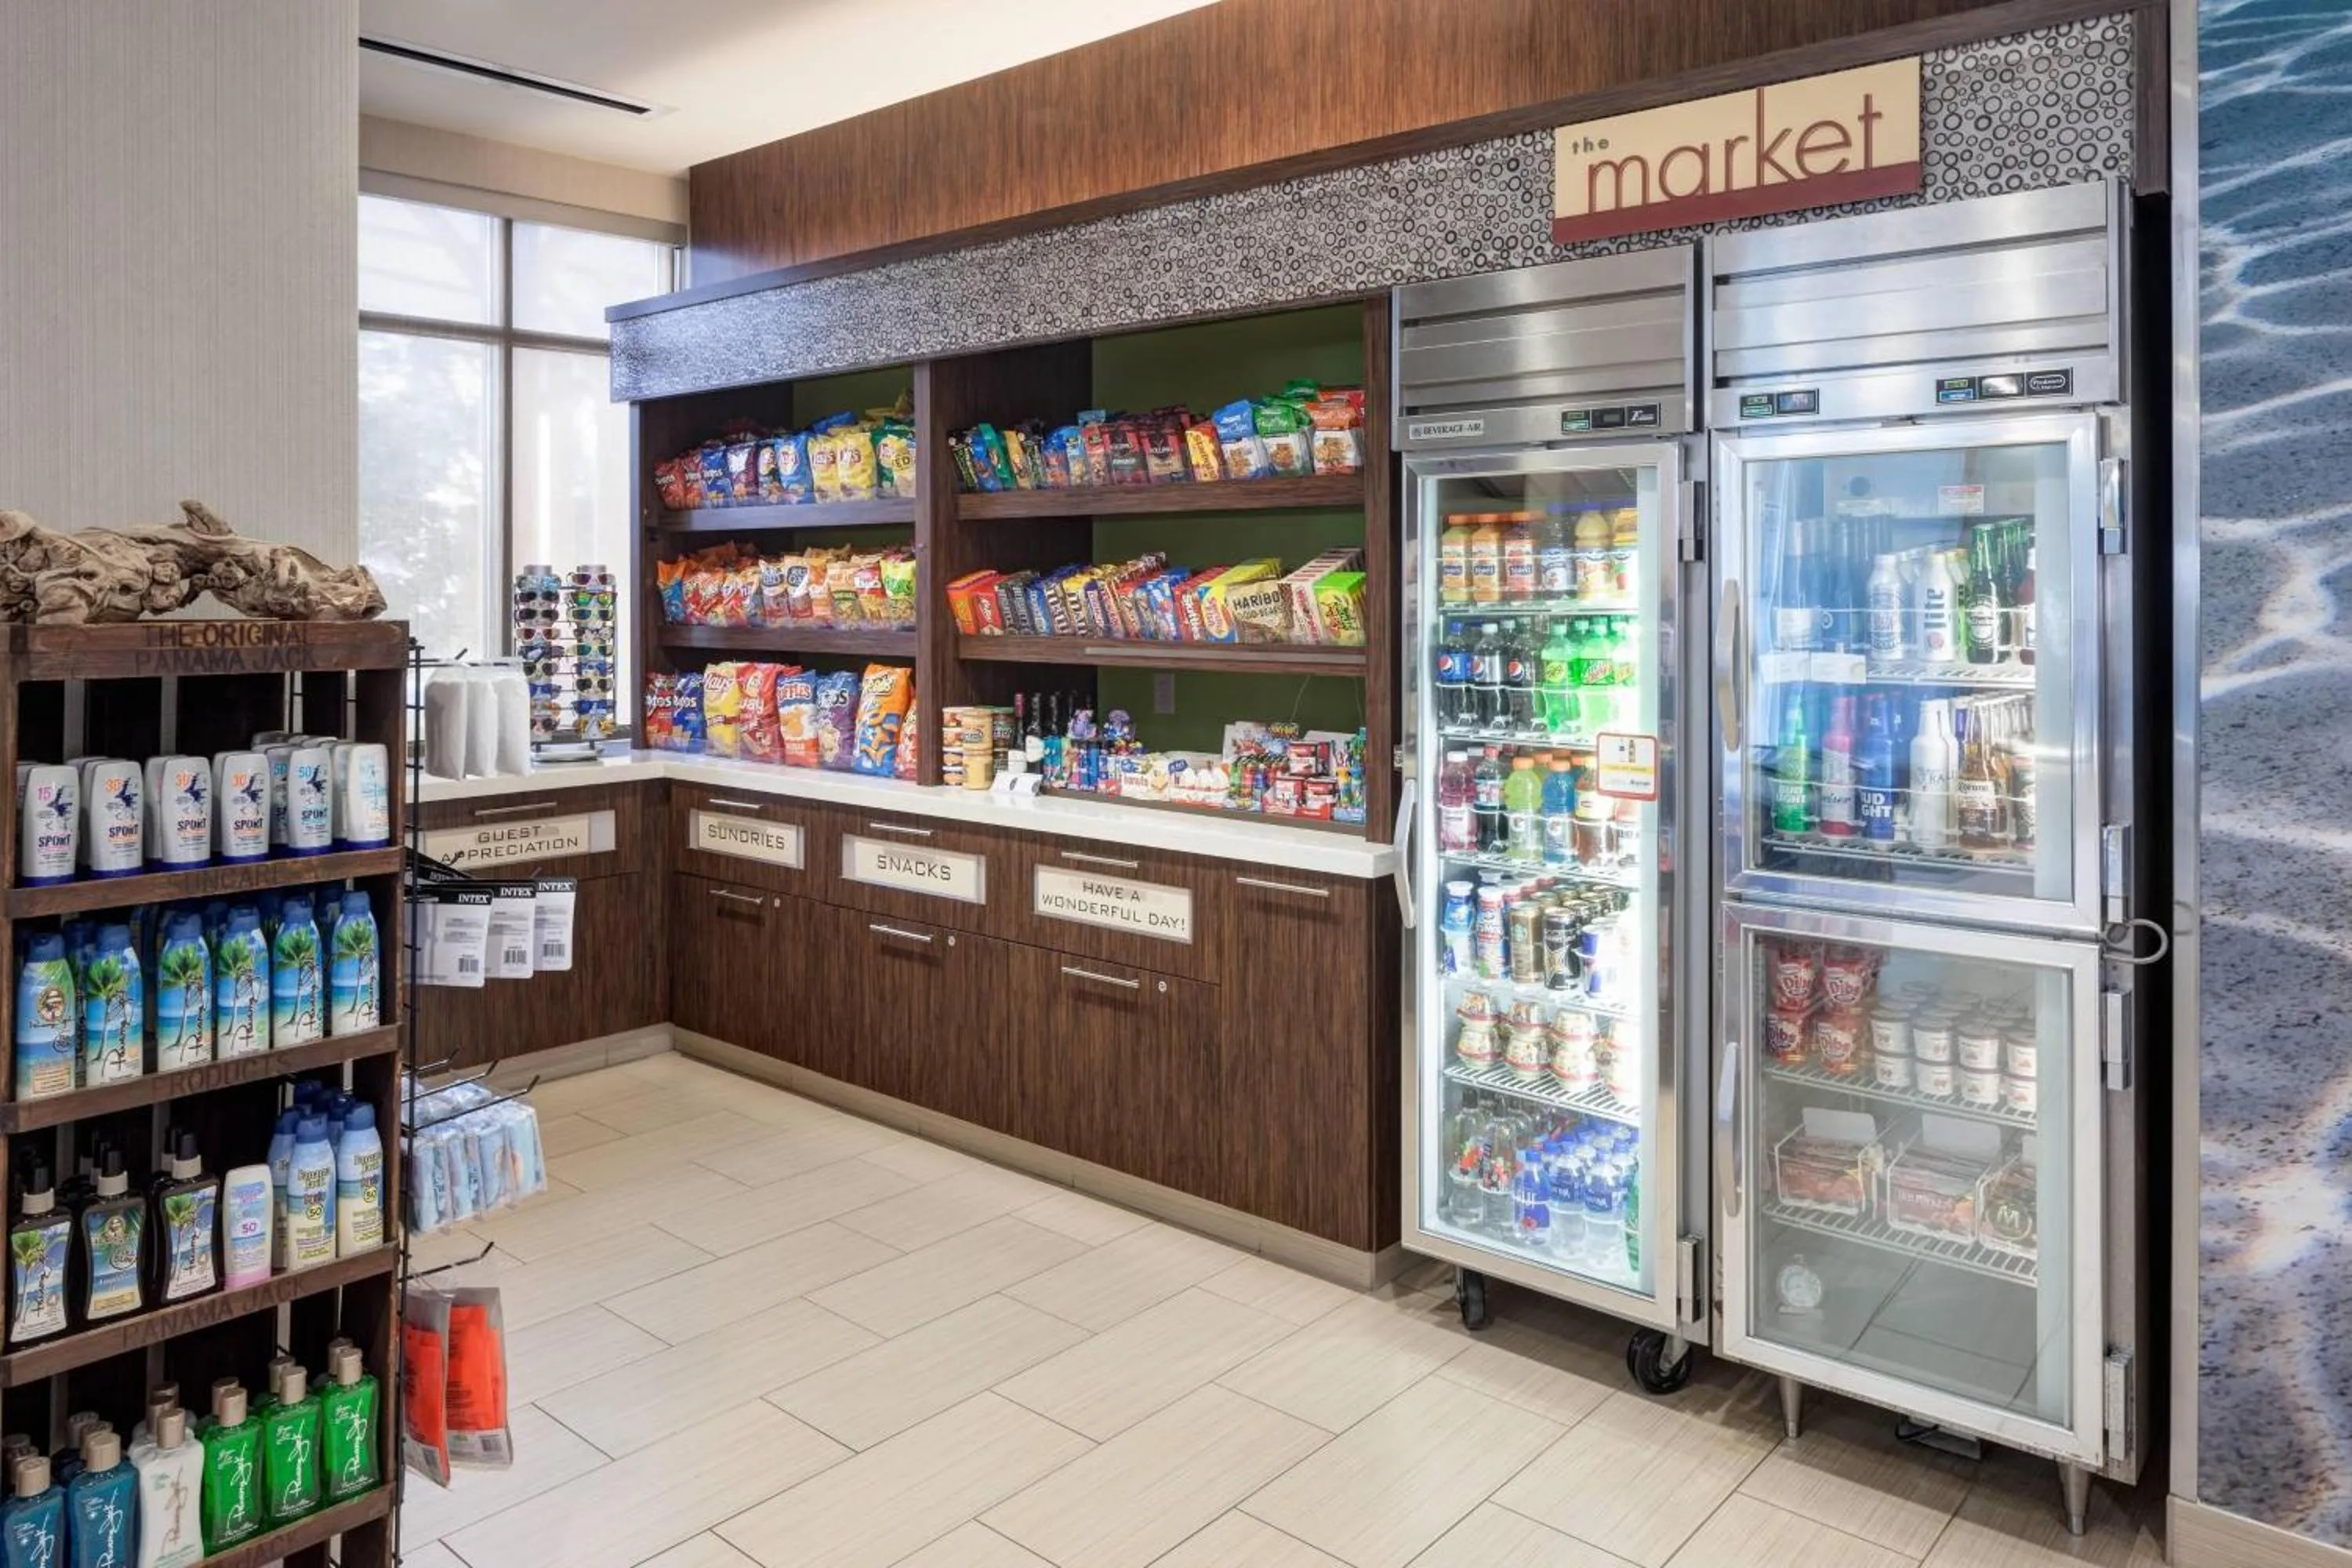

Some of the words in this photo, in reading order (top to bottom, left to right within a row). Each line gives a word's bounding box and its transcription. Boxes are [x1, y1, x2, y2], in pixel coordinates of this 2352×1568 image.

[1572, 136, 1610, 155] the
[1588, 87, 1882, 214] market
[1232, 590, 1279, 611] HARIBO
[143, 624, 193, 648] THE
[201, 622, 310, 648] ORIGINAL
[135, 648, 246, 677] PANAMA
[252, 647, 318, 670] JACK
[298, 765, 312, 779] 50
[37, 786, 52, 801] 15
[1862, 792, 1886, 805] UD
[301, 808, 328, 821] SPORT
[1862, 804, 1893, 818] GHT
[108, 824, 139, 838] SPORT
[176, 818, 207, 831] SPORT
[233, 818, 263, 830] SPORT
[38, 833, 71, 848] SPORT
[477, 826, 541, 844] GUEST
[708, 823, 785, 850] SUNDRIES
[877, 855, 952, 880] SNACKS
[500, 887, 534, 898] INTEX
[538, 882, 573, 891] INTEX
[1082, 881, 1123, 899] HAVE
[1130, 891, 1141, 902] A
[458, 893, 490, 904] INTEX
[1042, 893, 1142, 924] WONDERFUL
[1149, 912, 1185, 931] DAY!
[151, 1051, 292, 1101] PRODUCTS
[241, 1222, 257, 1233] 50
[123, 1298, 234, 1348] PANAMA
